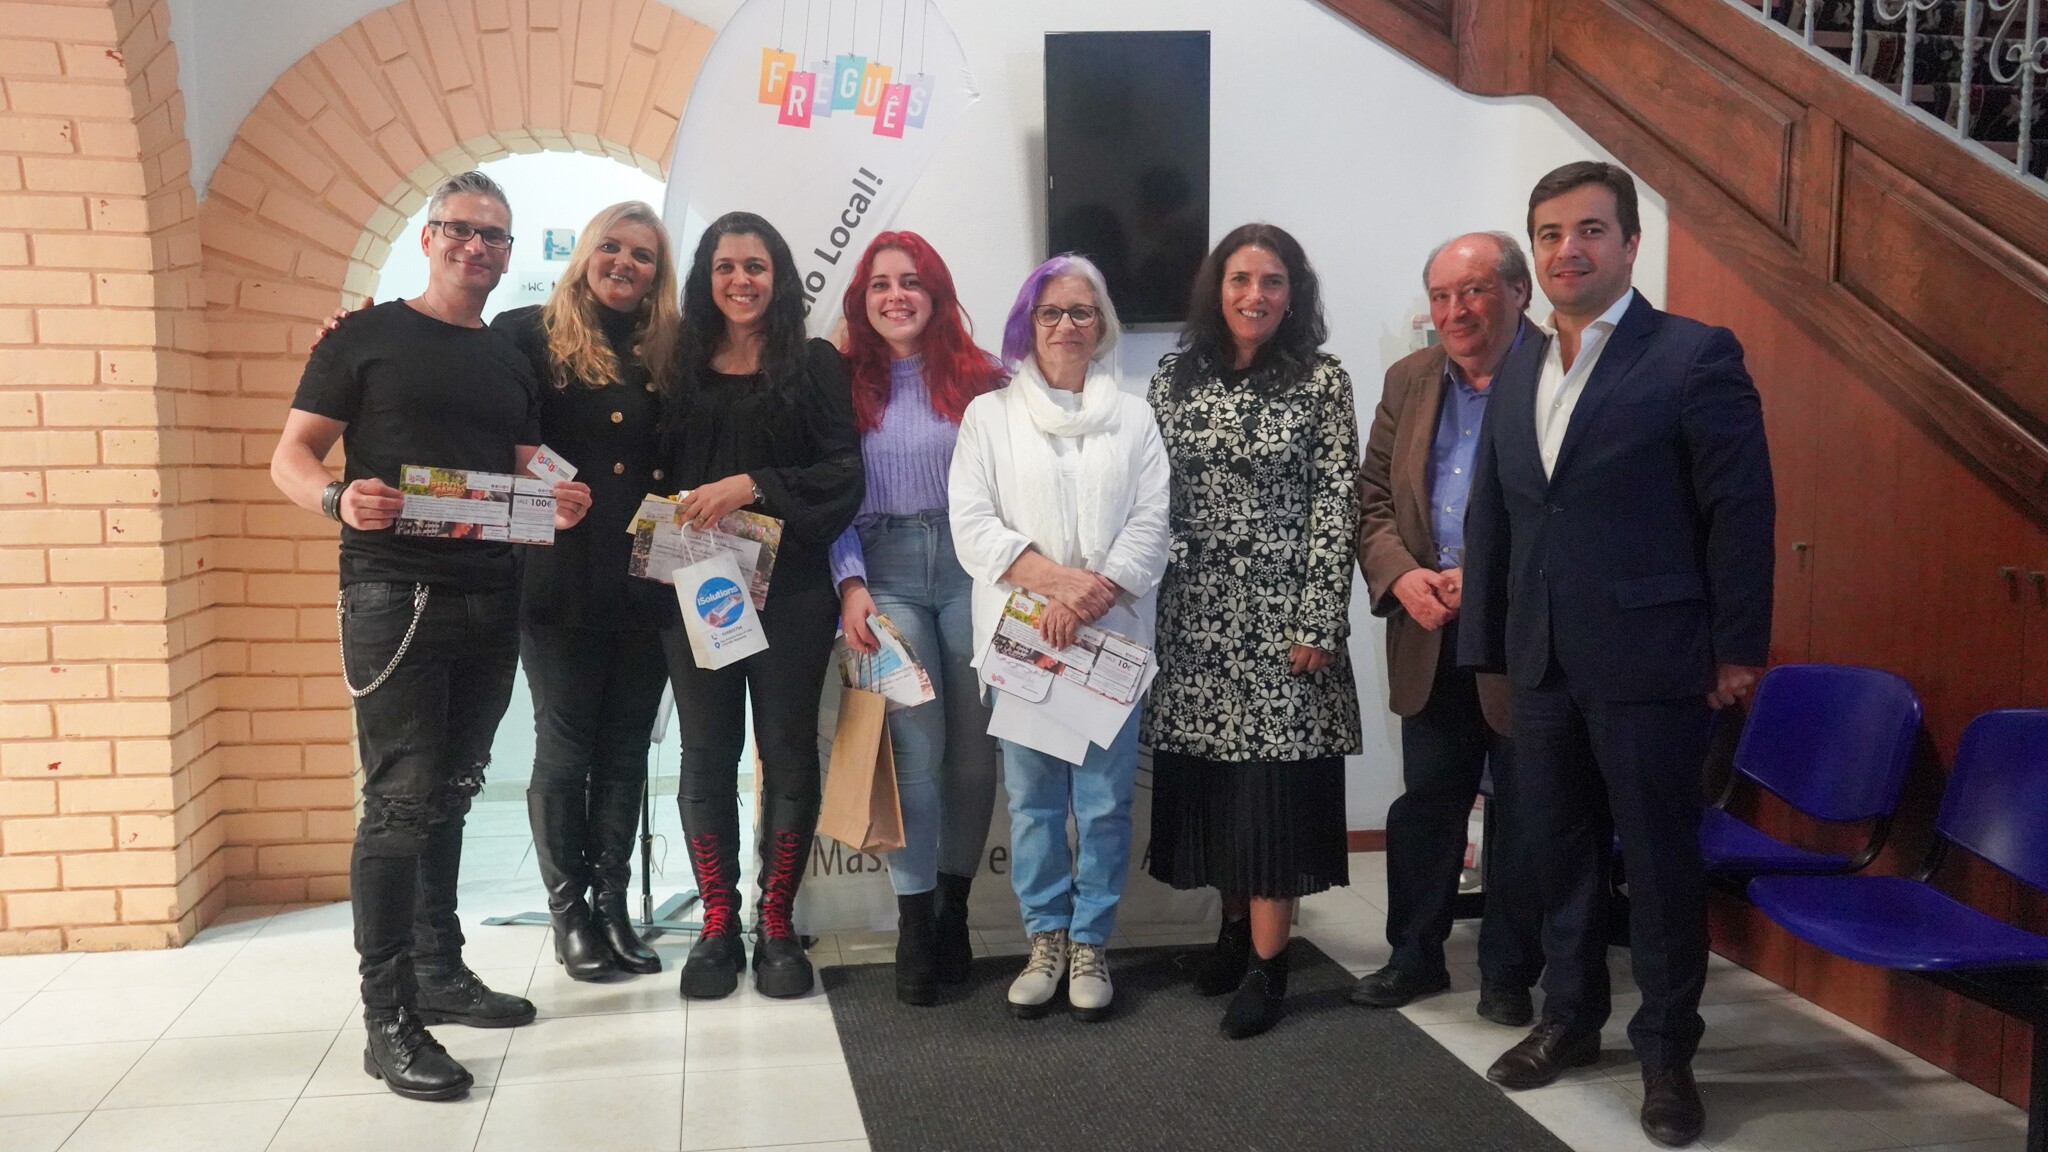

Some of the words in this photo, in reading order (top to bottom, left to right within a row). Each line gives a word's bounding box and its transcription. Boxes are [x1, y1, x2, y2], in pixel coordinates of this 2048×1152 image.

[765, 60, 926, 129] FREGUÊS
[813, 166, 884, 266] Local!
[528, 281, 545, 292] WC
[531, 498, 552, 508] 100€
[1118, 659, 1133, 672] 10€
